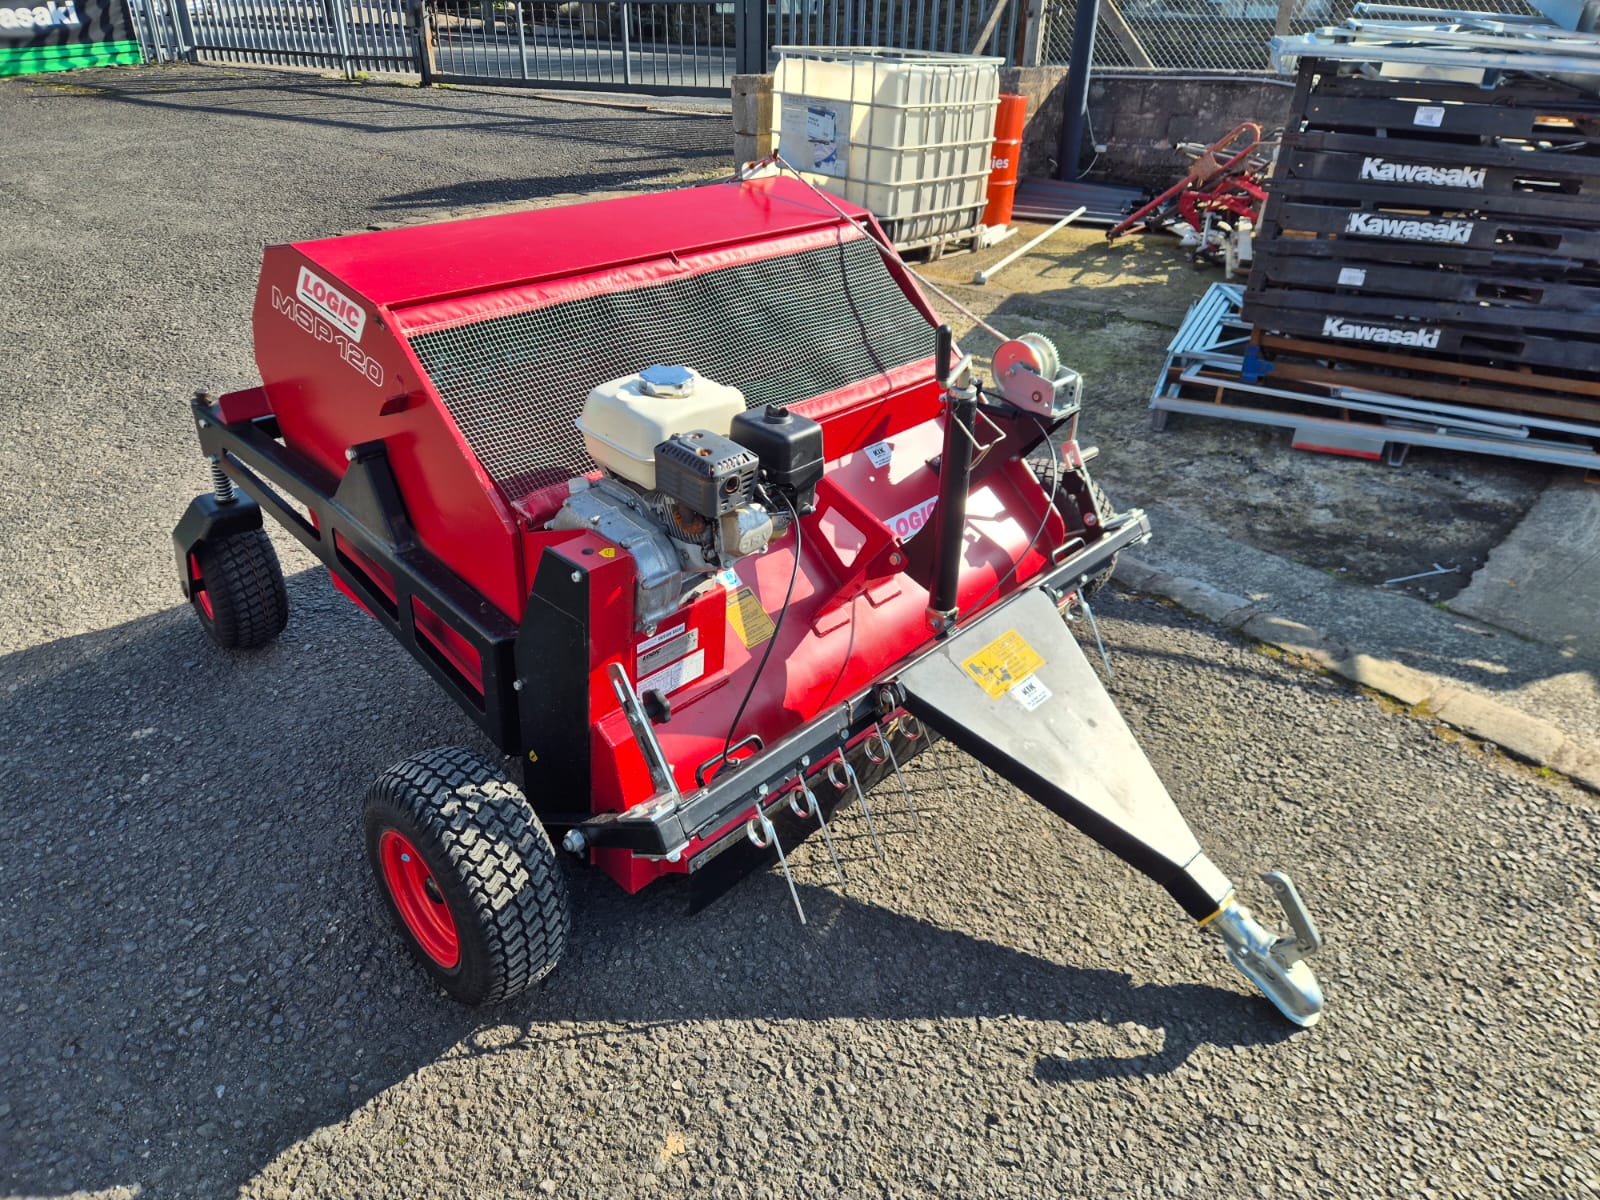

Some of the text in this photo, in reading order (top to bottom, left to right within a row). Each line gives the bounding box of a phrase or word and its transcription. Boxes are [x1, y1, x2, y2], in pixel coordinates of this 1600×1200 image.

[1361, 156, 1487, 189] Kawasaki
[1348, 212, 1474, 244] Kawasaki
[302, 273, 361, 328] LOGIC
[1322, 315, 1442, 349] Kawasaki
[887, 502, 936, 536] OGI
